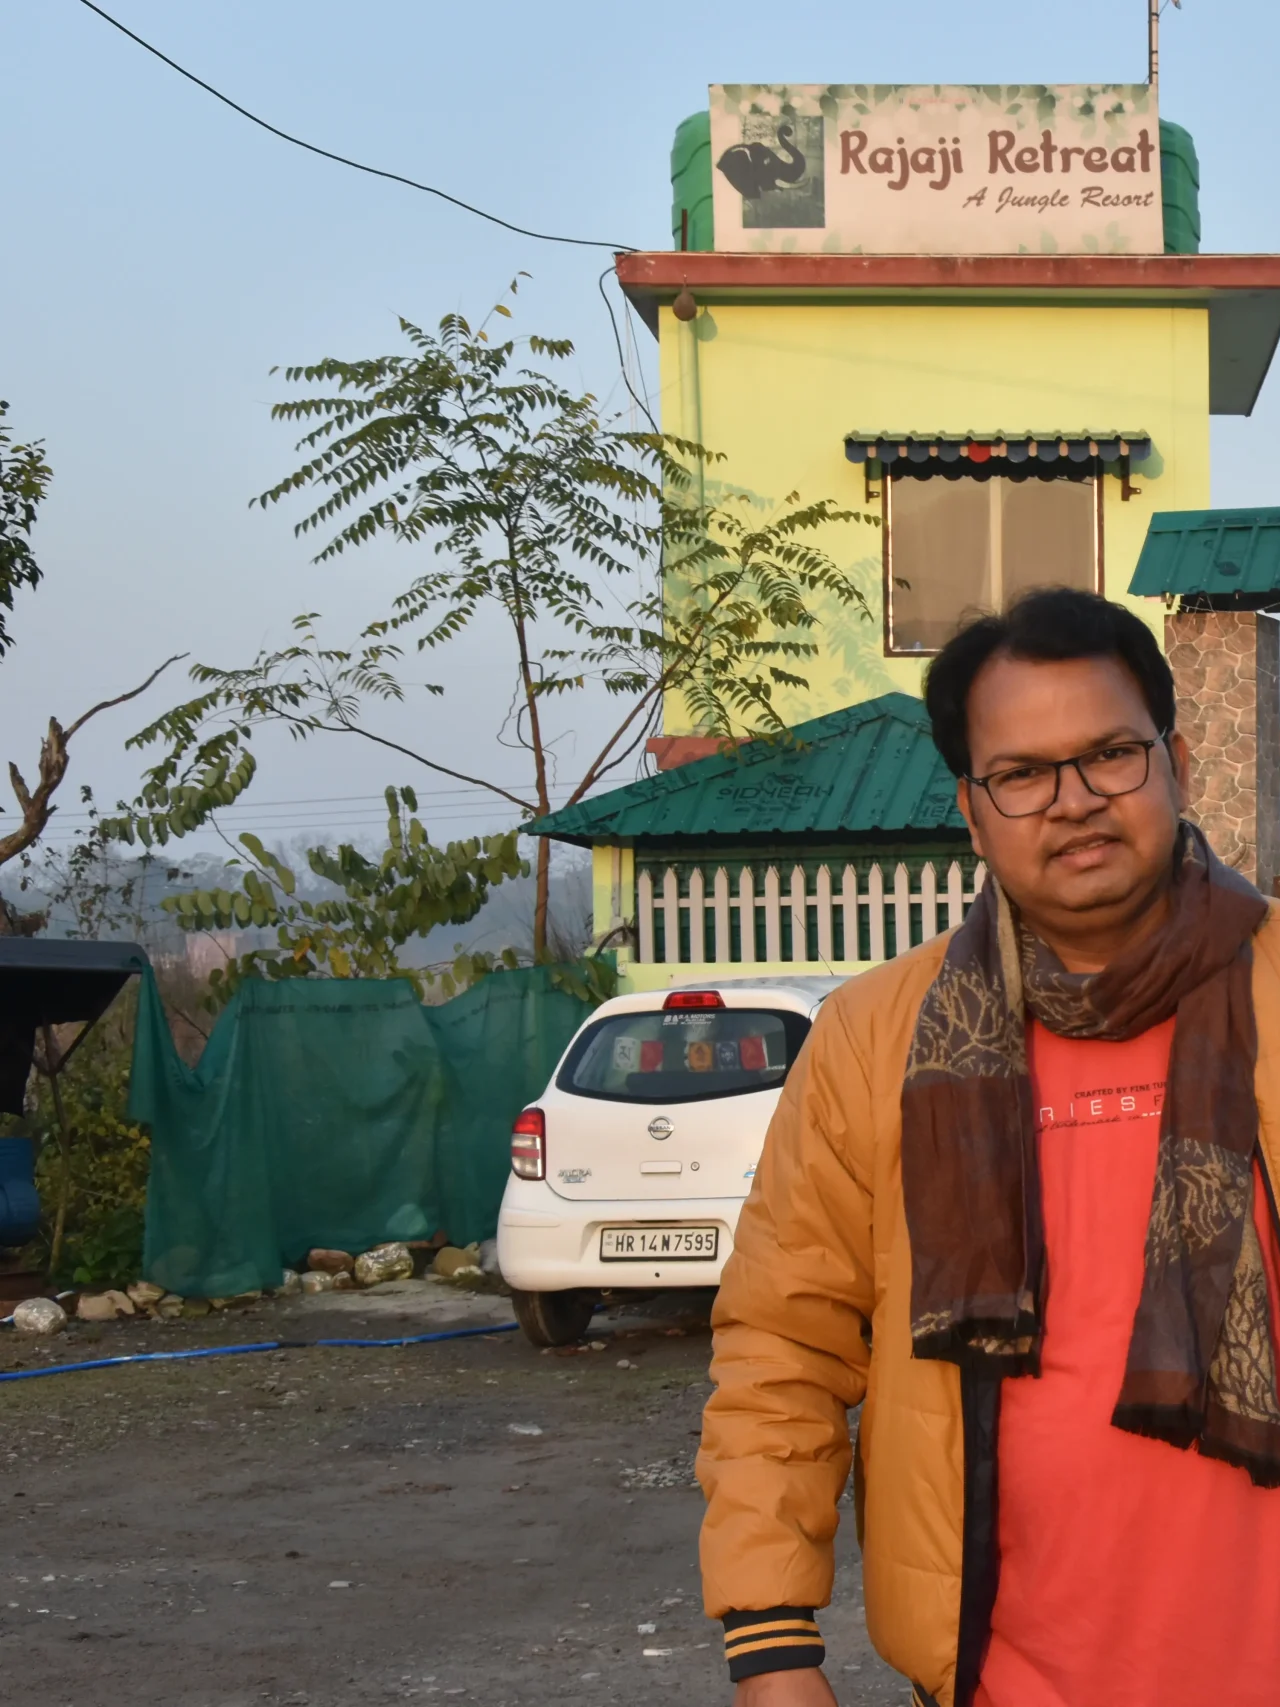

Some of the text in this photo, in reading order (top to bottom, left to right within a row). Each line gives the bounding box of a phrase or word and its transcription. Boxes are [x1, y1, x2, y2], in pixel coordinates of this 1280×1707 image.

[839, 128, 1155, 191] Rajaji Retreat
[962, 186, 1155, 214] A Jungle Resort
[1074, 1088, 1114, 1099] CRAFTED
[1116, 1086, 1128, 1094] BY
[1130, 1083, 1151, 1093] FINE
[615, 1234, 635, 1252] HR
[674, 1234, 714, 1251] 7595
